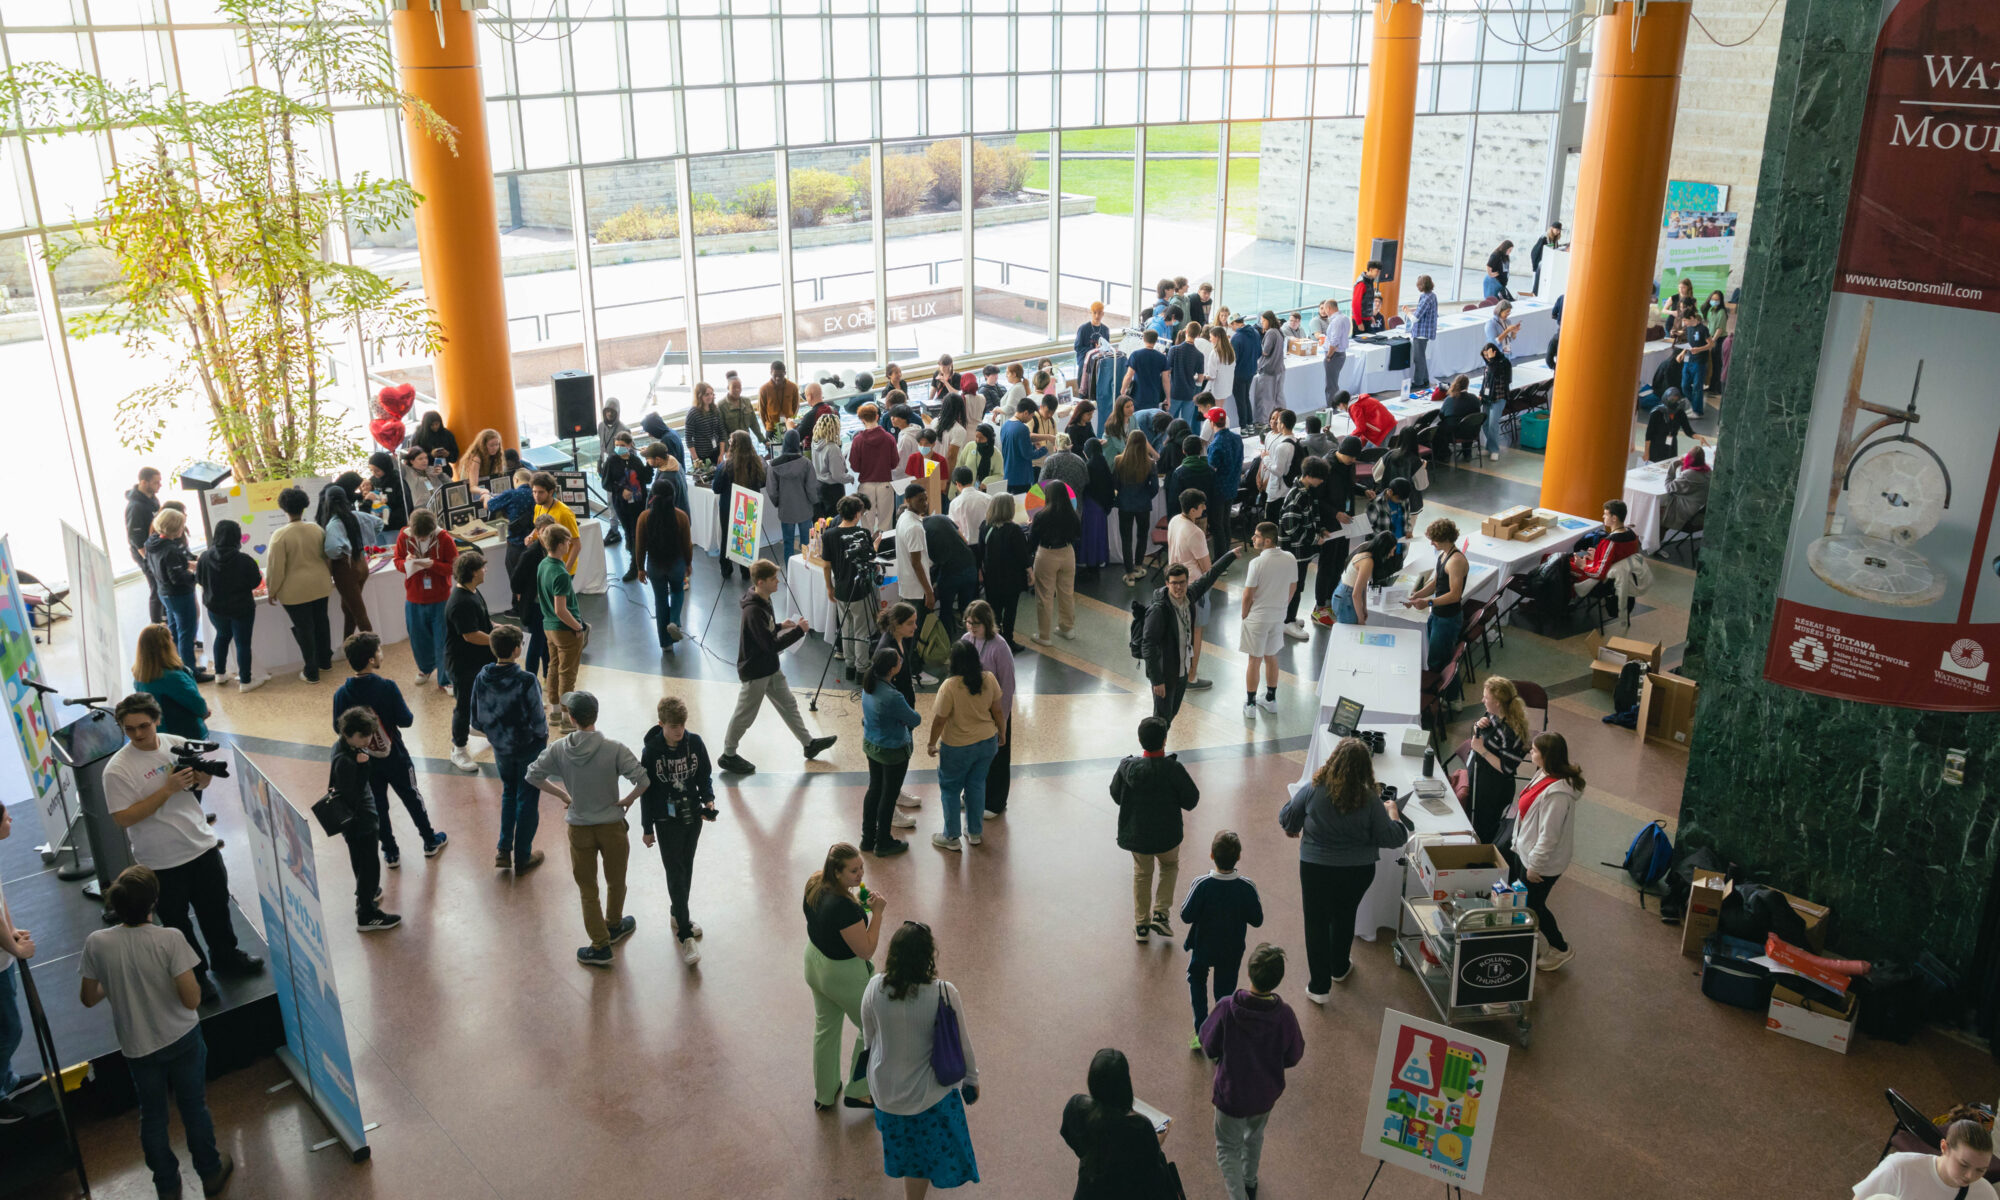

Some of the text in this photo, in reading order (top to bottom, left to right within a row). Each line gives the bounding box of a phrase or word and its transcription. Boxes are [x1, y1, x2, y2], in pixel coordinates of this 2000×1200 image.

[1845, 273, 1983, 300] www.watsonsmill.com
[824, 302, 937, 332] EX ORIETE LUX
[1795, 617, 1841, 634] RÉSEAU DES
[1794, 624, 1876, 651] MUSÉES D'OTTAWA
[1832, 642, 1911, 668] MUSEUM NETWORK
[1973, 682, 1991, 693] MILL
[1479, 956, 1512, 968] ROLLING
[1475, 973, 1512, 985] THUNDER
